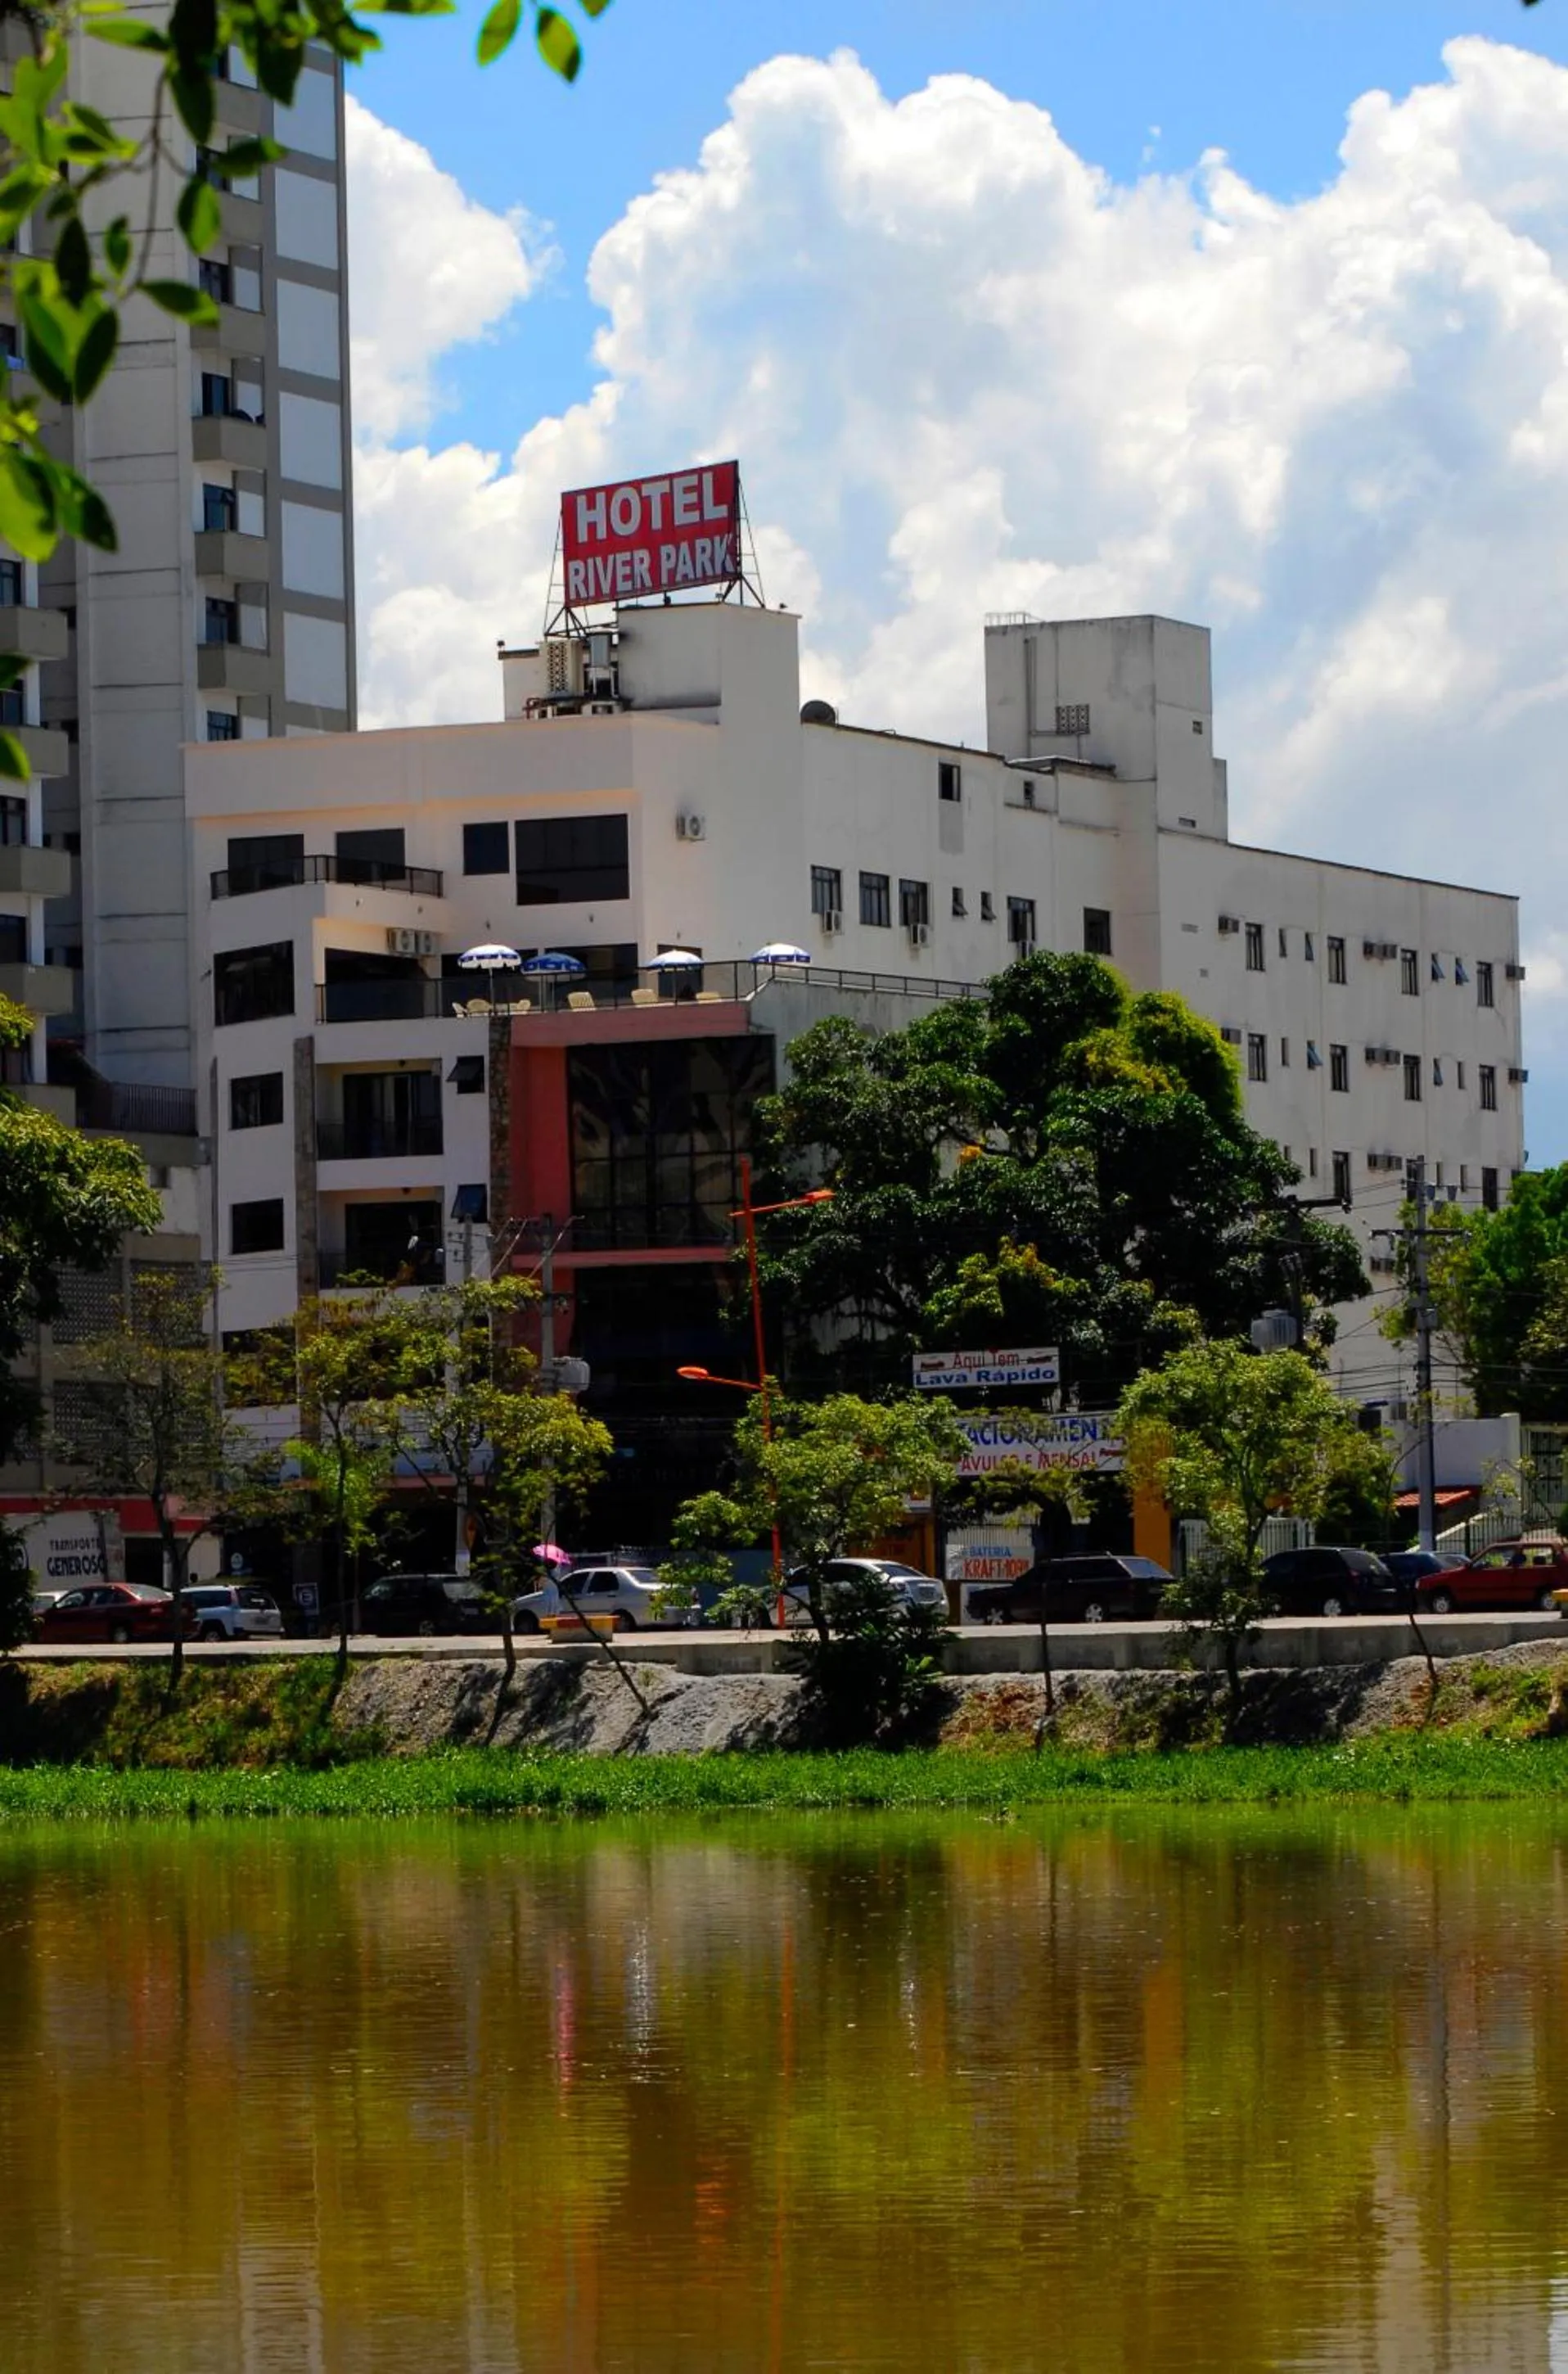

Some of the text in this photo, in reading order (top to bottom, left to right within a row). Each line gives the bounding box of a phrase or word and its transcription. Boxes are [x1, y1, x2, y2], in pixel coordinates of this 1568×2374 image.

[576, 471, 728, 544] HOTEL
[567, 533, 735, 600] RIVER PARK
[915, 1366, 1055, 1386] Lava Rápido
